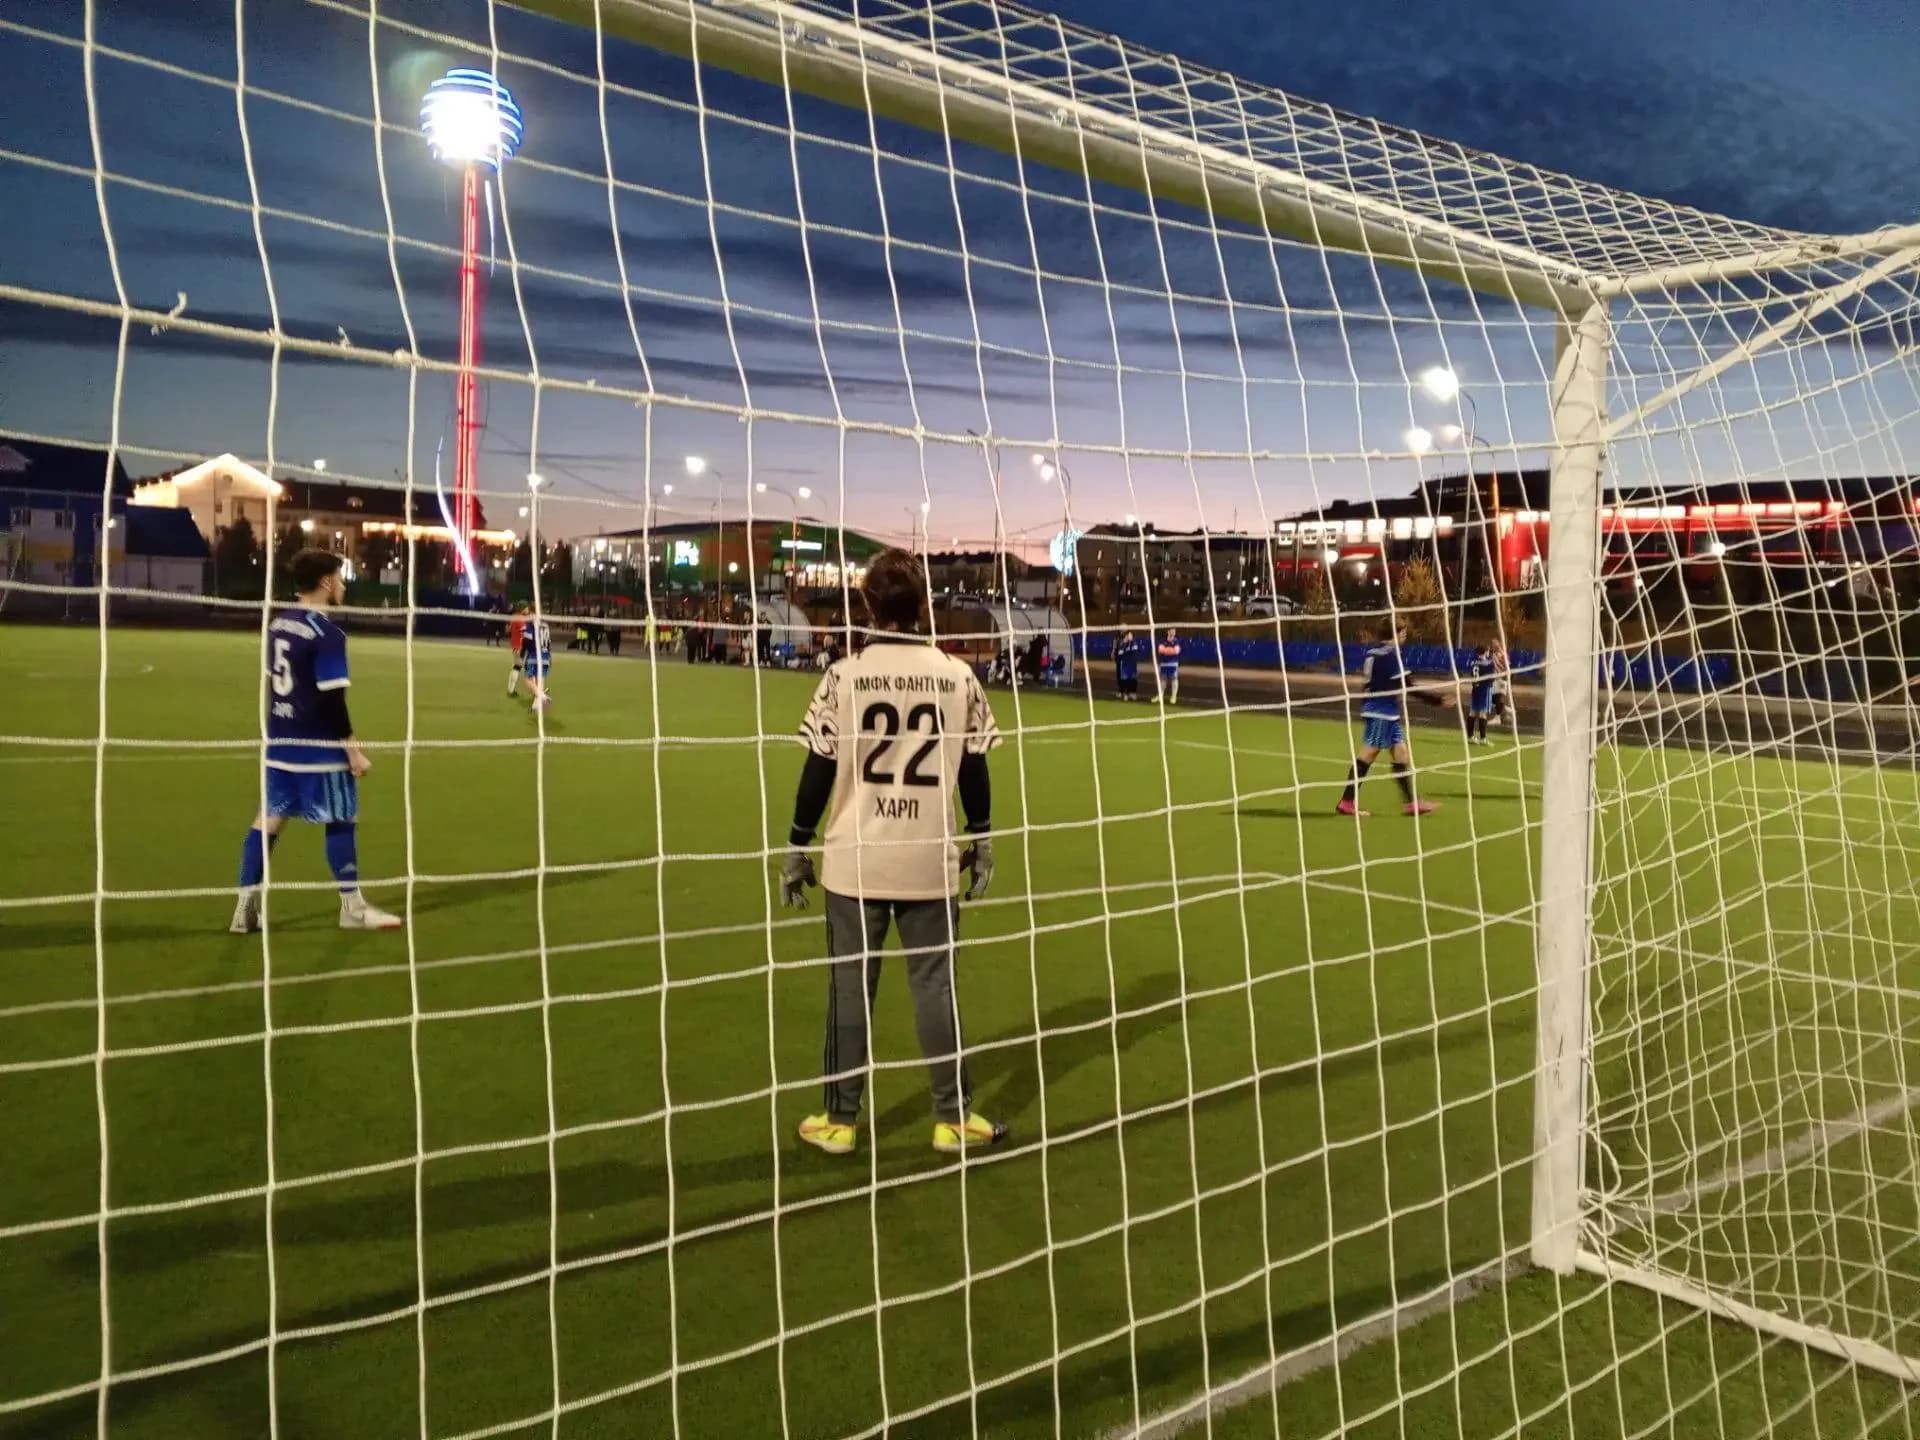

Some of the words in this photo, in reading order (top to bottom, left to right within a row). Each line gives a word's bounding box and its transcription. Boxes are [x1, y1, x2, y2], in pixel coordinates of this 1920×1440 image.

[270, 637, 294, 697] 5
[861, 702, 945, 787] 22
[874, 796, 919, 819] ХАРП
